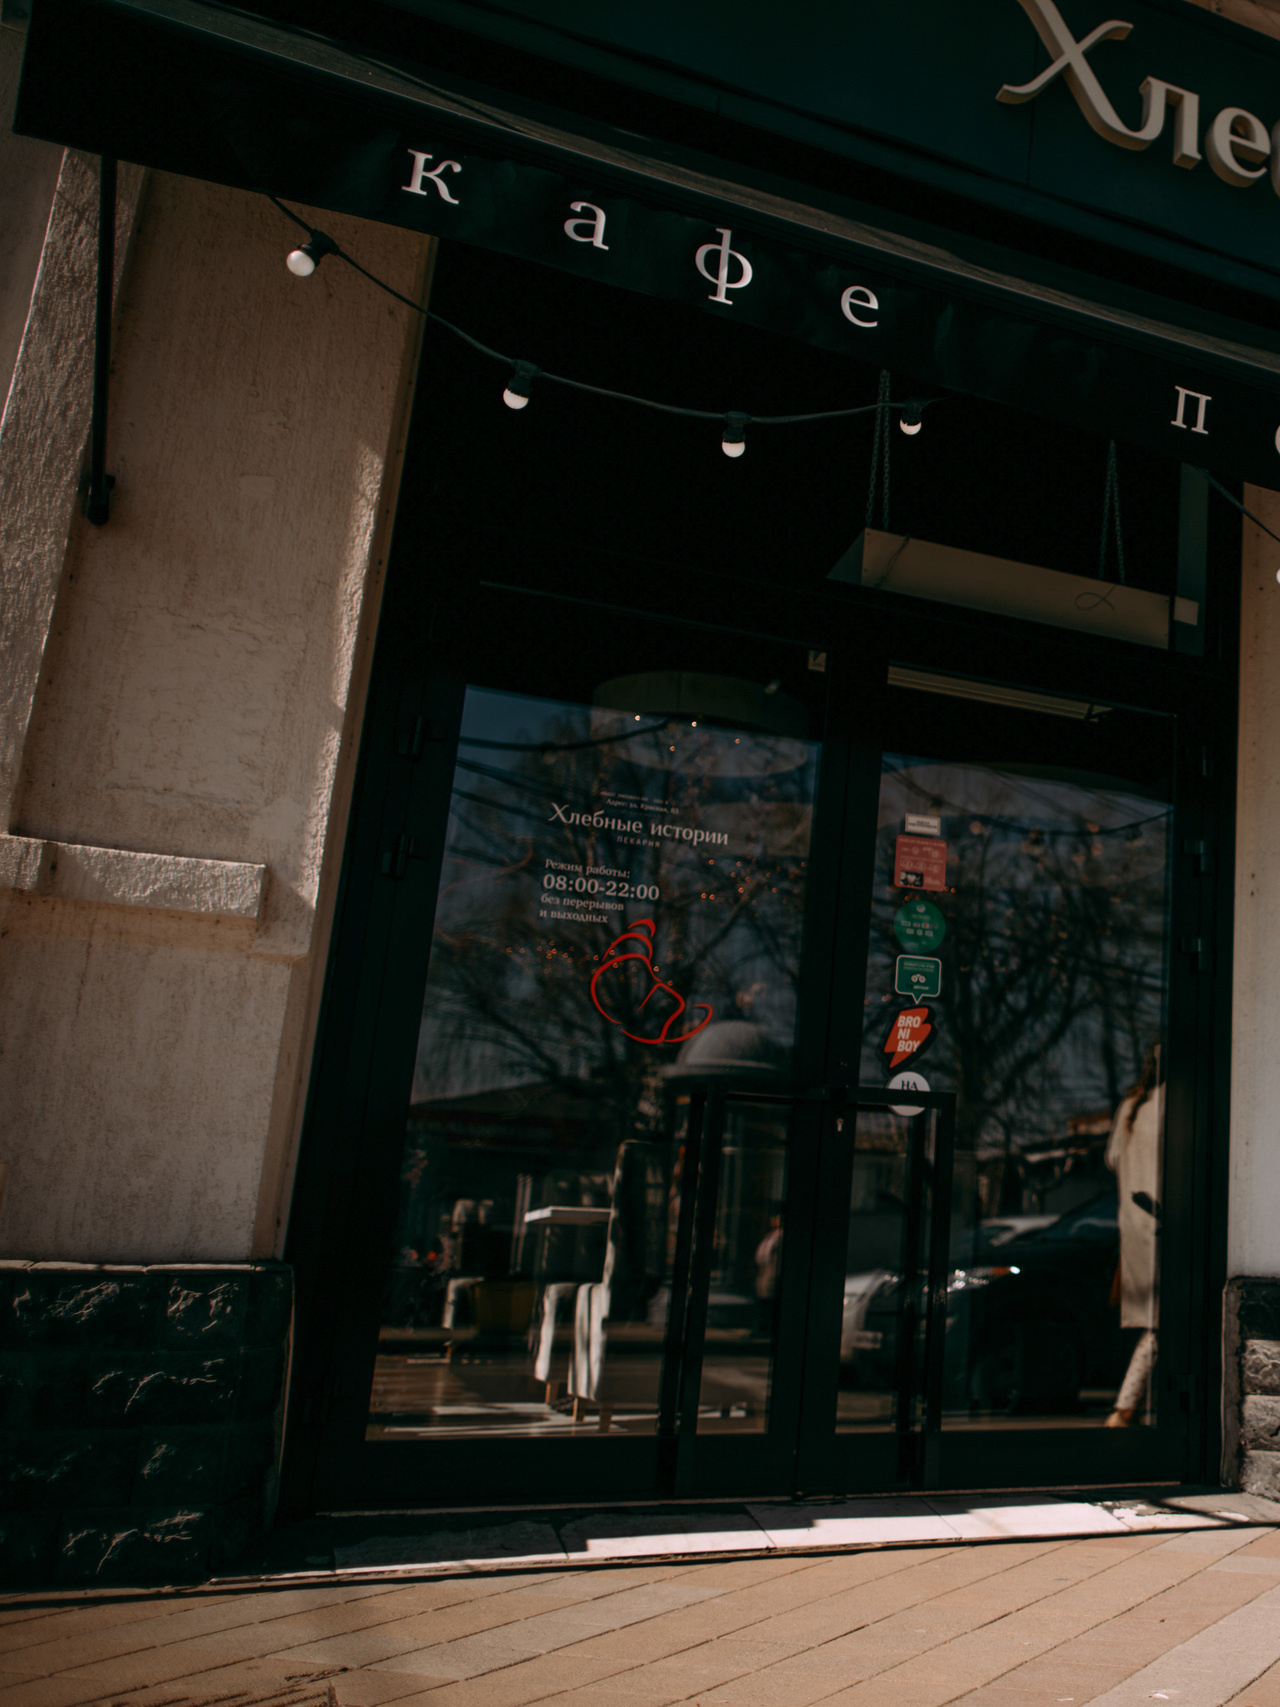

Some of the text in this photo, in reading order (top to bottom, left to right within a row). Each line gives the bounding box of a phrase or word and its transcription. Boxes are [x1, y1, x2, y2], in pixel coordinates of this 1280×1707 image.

[401, 148, 880, 329] кафе
[547, 802, 729, 846] Хлебные истории
[616, 835, 661, 848] ПЕКАРНЯ
[545, 859, 630, 879] Режим работы:
[542, 873, 660, 901] 08:00-22:00
[540, 893, 625, 912] без перерывов
[539, 909, 609, 924] и выходных
[897, 1015, 921, 1029] BRO
[896, 1028, 911, 1040] NI
[896, 1040, 921, 1052] BOY
